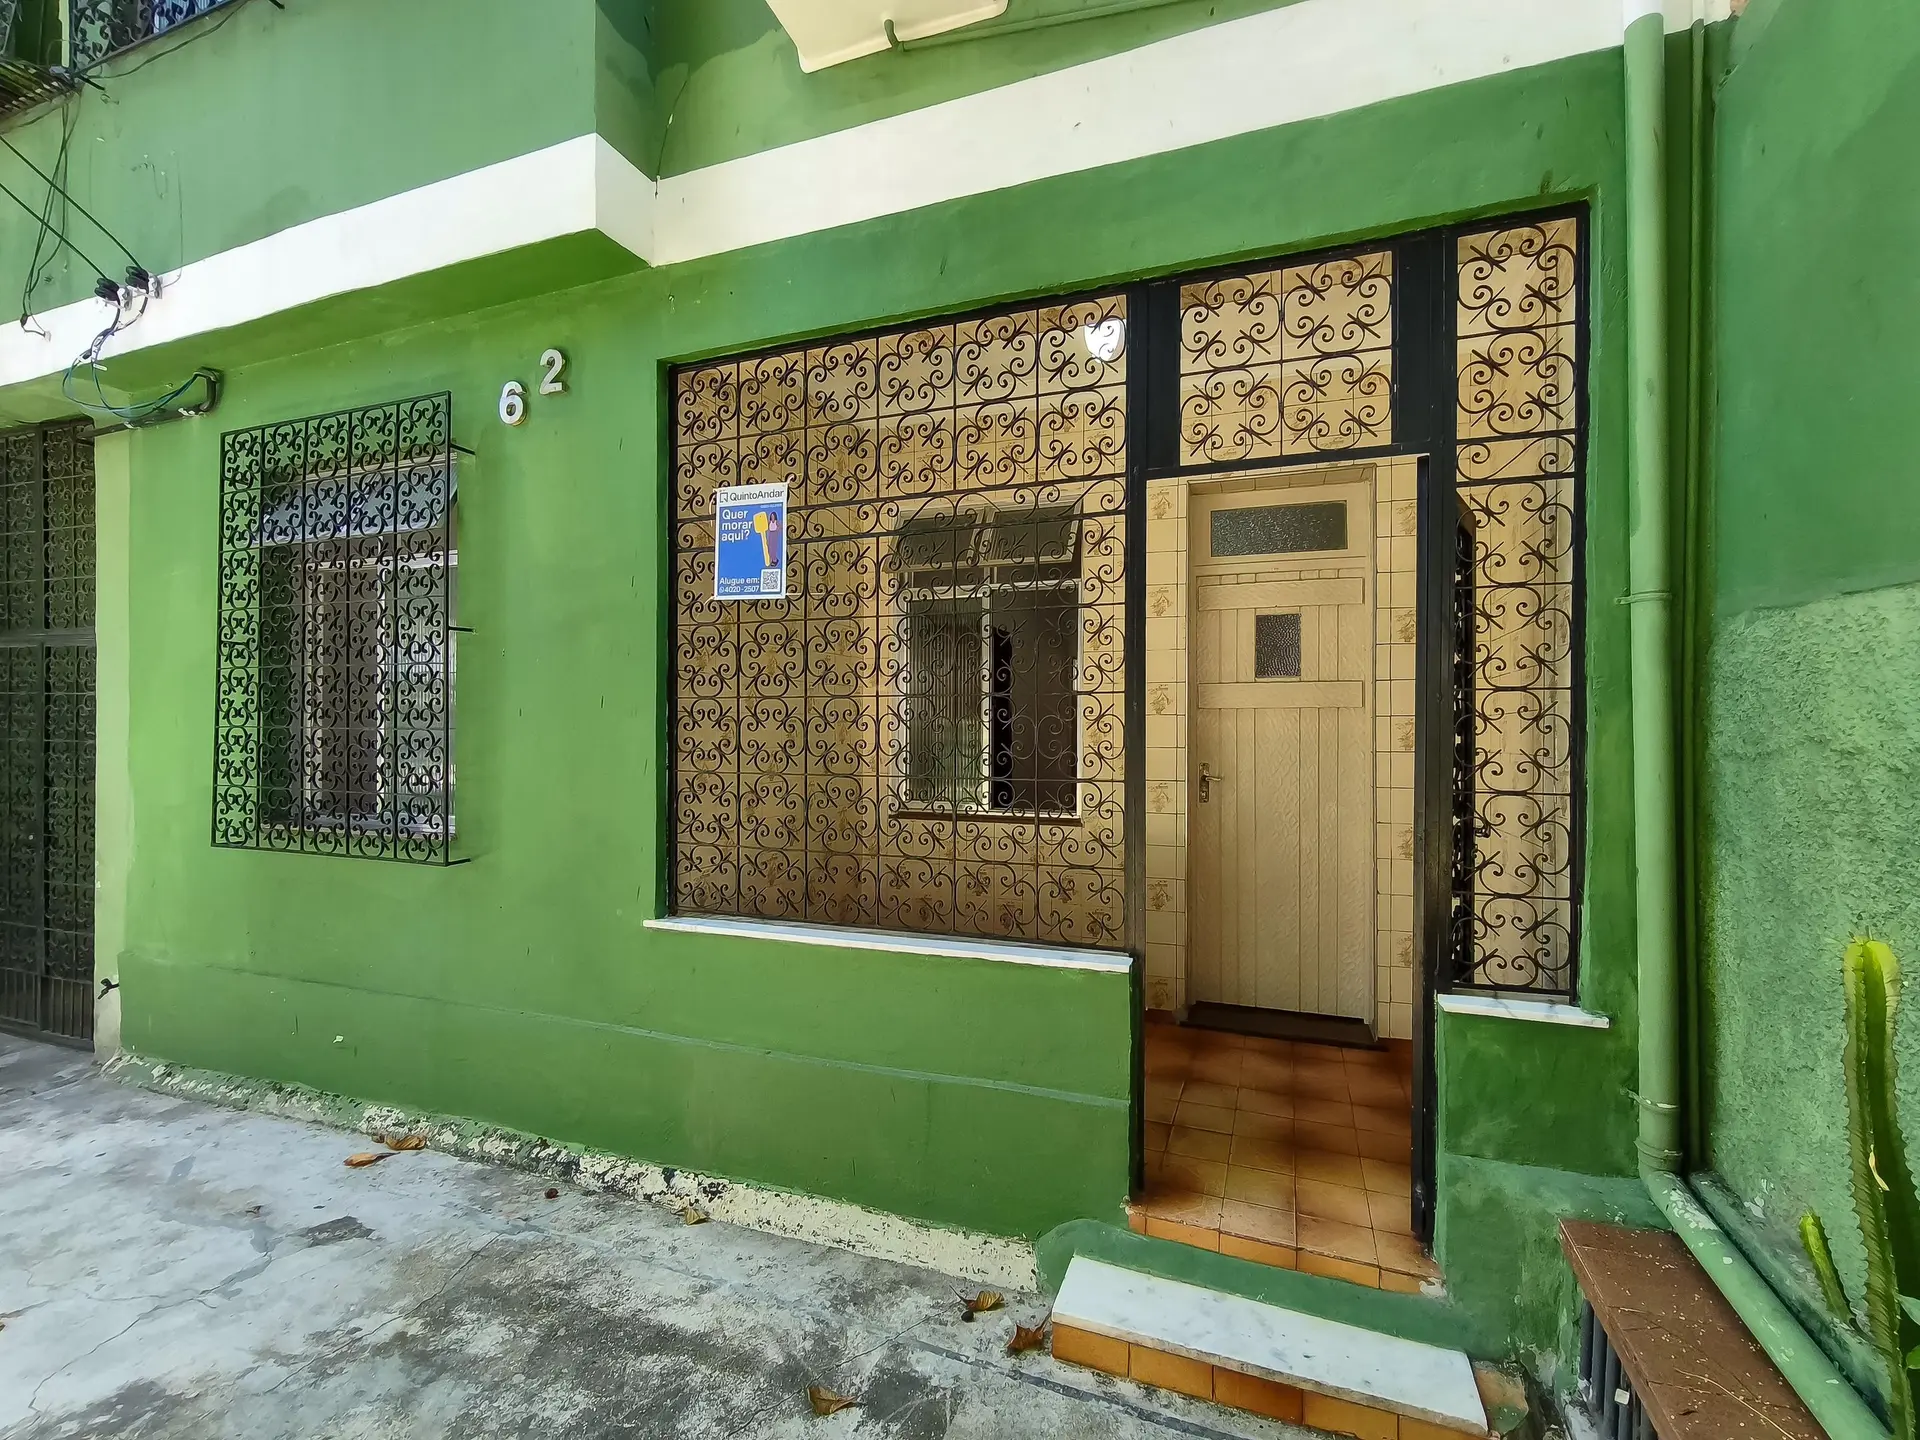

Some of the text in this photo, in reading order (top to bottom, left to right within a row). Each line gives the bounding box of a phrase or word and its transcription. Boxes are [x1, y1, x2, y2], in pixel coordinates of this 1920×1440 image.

[729, 489, 784, 502] QuintoAndar
[722, 509, 749, 520] Quer
[722, 521, 753, 530] morar
[721, 530, 750, 543] aqui?
[720, 577, 745, 586] Alugue
